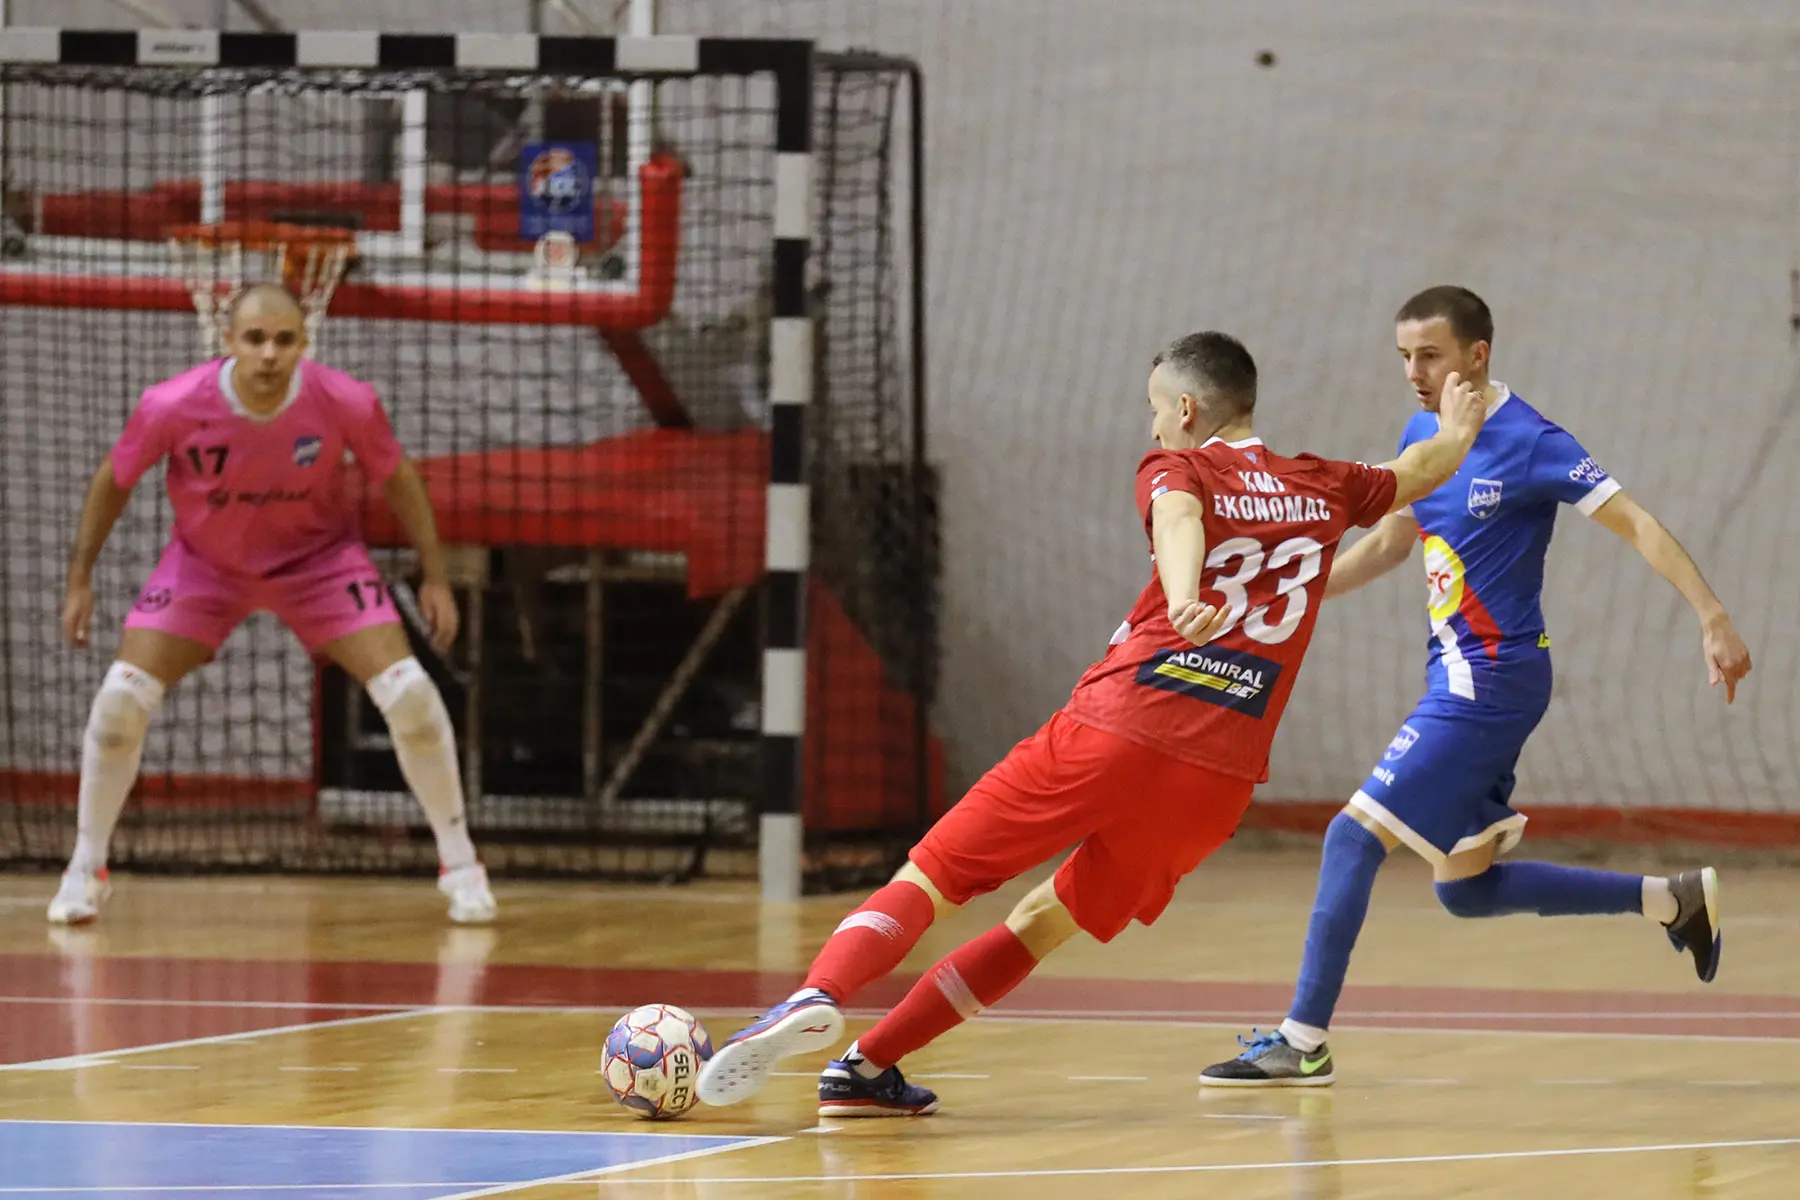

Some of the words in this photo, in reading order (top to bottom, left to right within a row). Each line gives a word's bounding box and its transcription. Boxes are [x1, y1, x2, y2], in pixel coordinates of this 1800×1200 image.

[187, 445, 229, 475] 17
[346, 580, 384, 610] 17
[1205, 536, 1323, 645] 33
[1165, 651, 1264, 689] ADMIRAL
[1225, 682, 1261, 699] BET
[670, 1052, 690, 1109] SELECT
